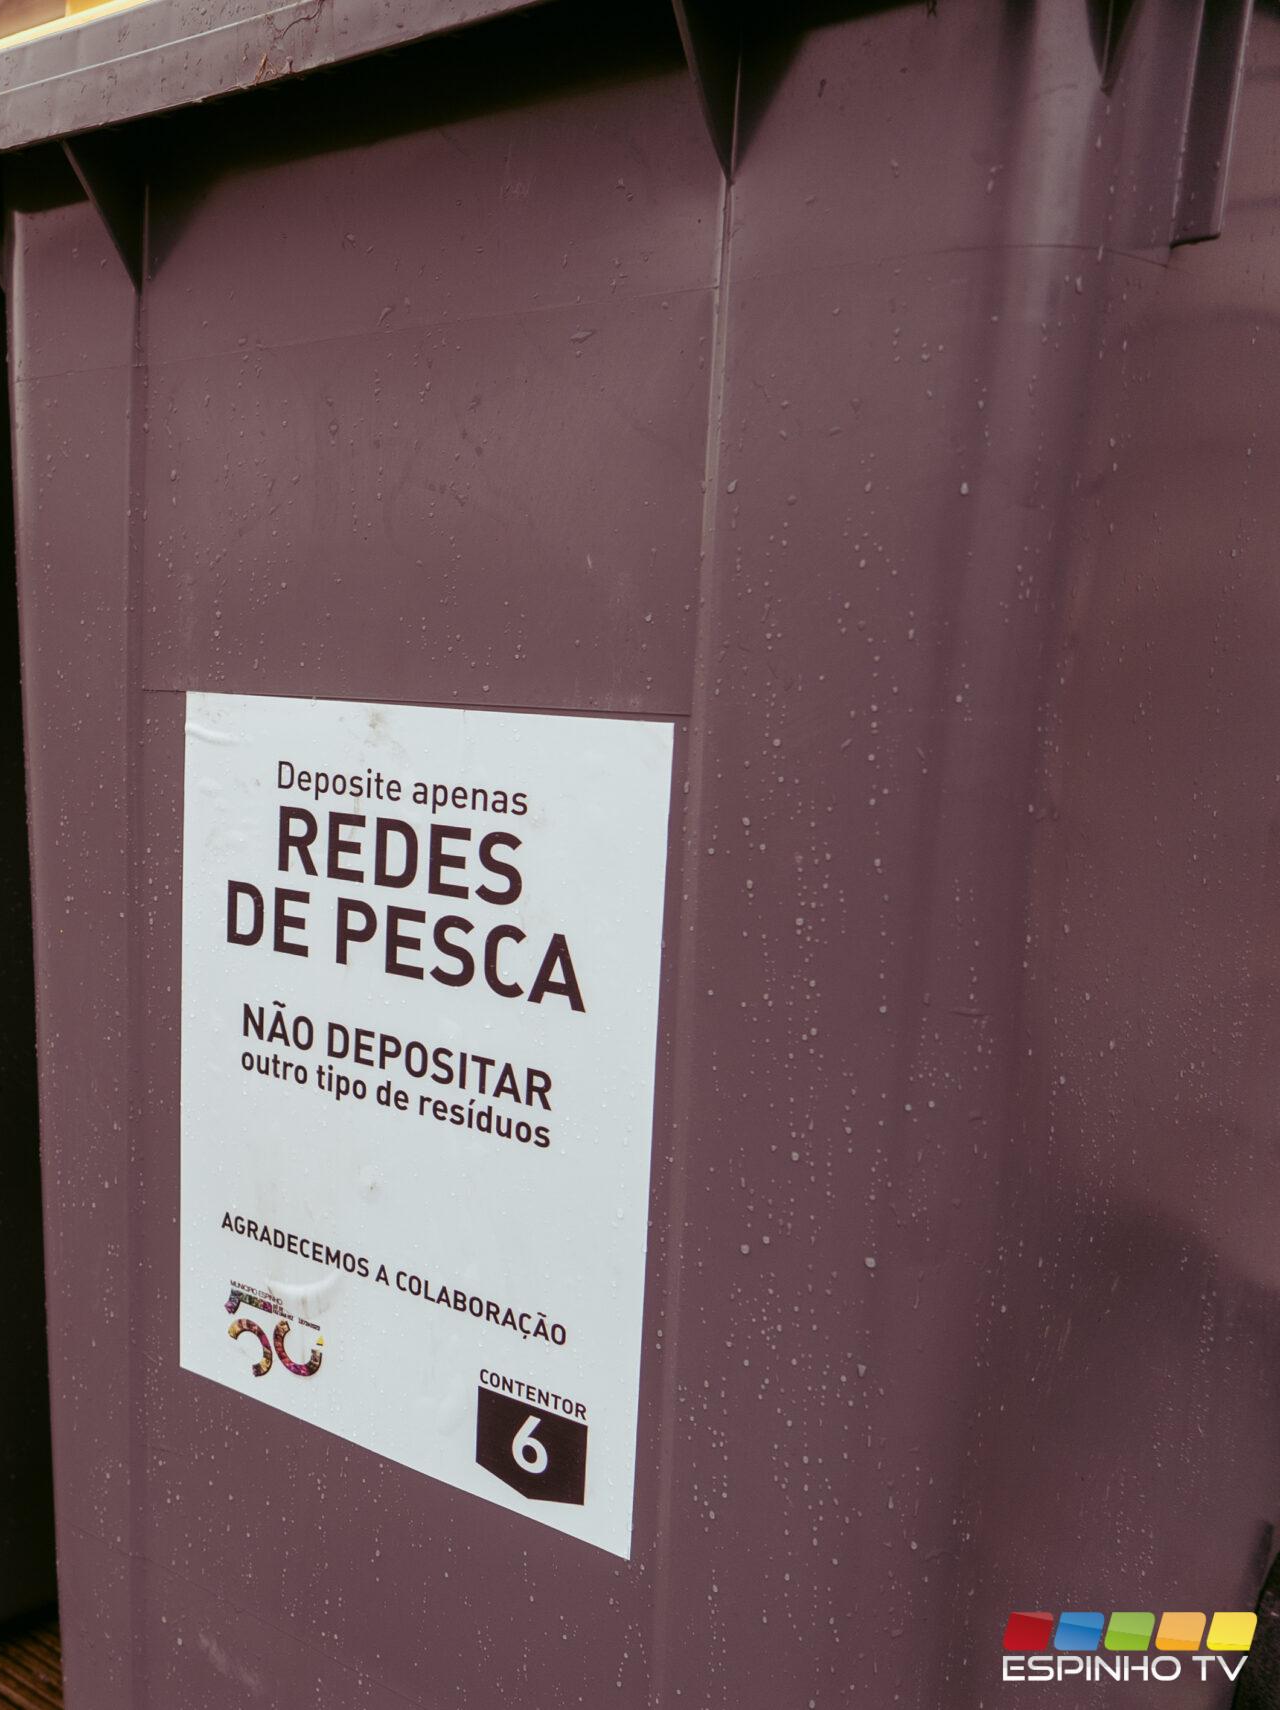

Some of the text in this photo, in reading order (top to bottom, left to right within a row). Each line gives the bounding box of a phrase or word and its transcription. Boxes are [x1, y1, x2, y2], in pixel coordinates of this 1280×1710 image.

[277, 760, 529, 817] Deposite apenas
[277, 805, 524, 906] REDES
[226, 879, 587, 1014] DE PESCA
[240, 1049, 552, 1149] outro tipo de resíduos
[242, 1000, 554, 1112] NÃO DEPOSITAR
[221, 1211, 568, 1347] AGRADECEMOS A COLABORAÇÃO
[479, 1368, 589, 1421] CONTENTOR
[511, 1414, 549, 1475] 6
